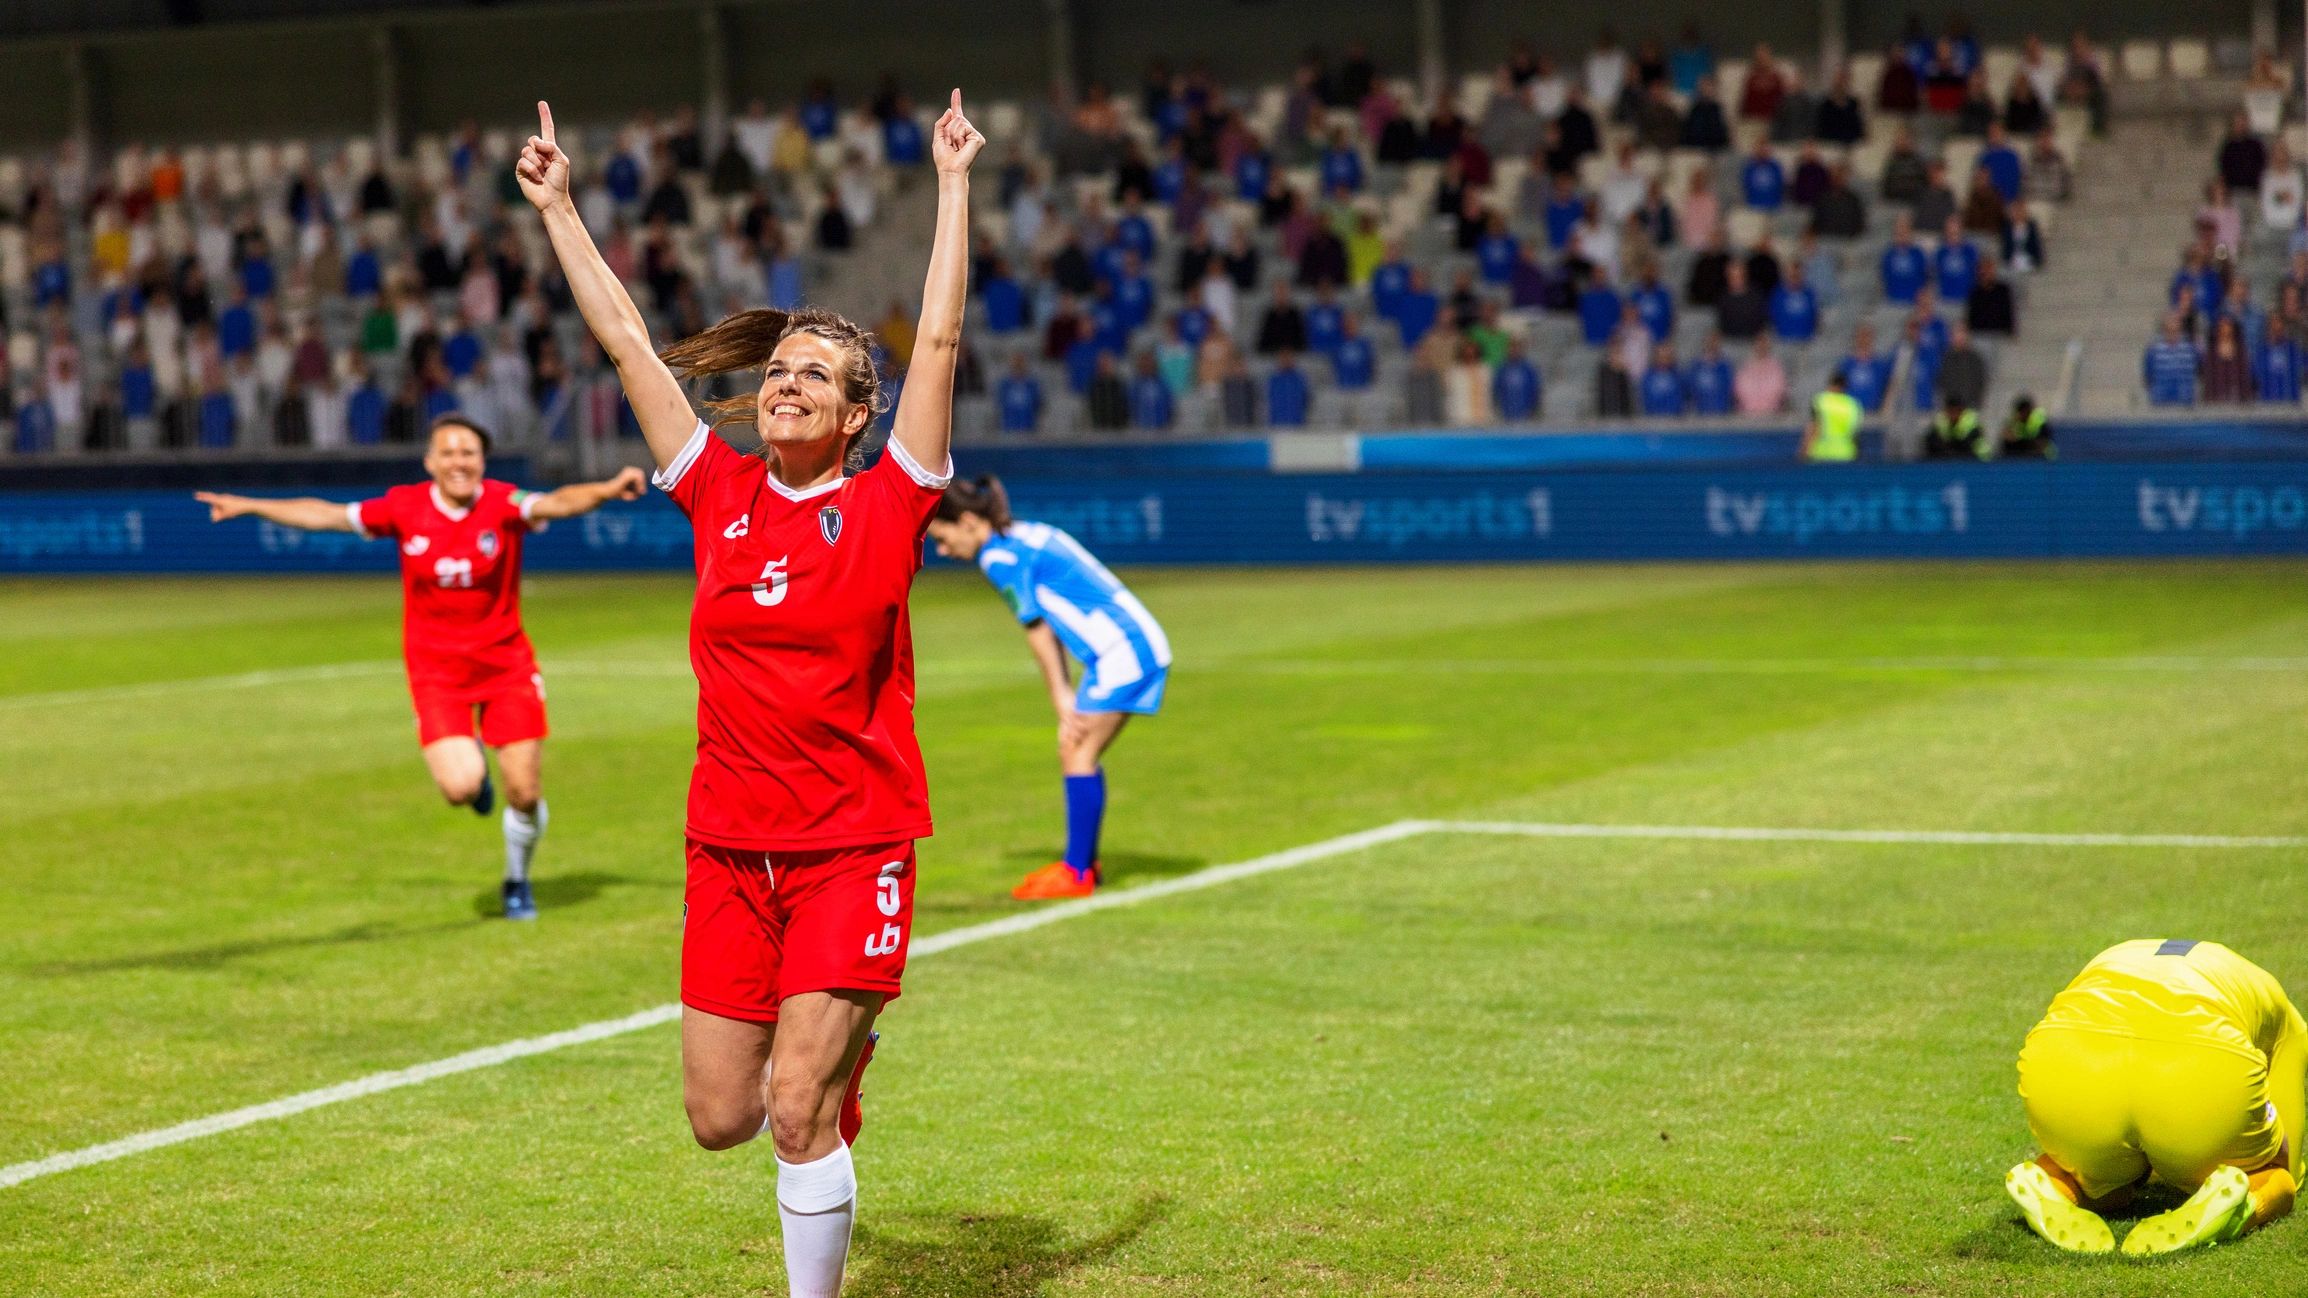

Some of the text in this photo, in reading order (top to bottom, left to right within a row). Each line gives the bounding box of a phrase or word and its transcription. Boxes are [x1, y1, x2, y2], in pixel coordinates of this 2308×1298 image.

[1305, 488, 1551, 549] tvsports1
[1704, 483, 1967, 545] tvsports1
[751, 555, 788, 607] 5
[877, 861, 904, 917] 5
